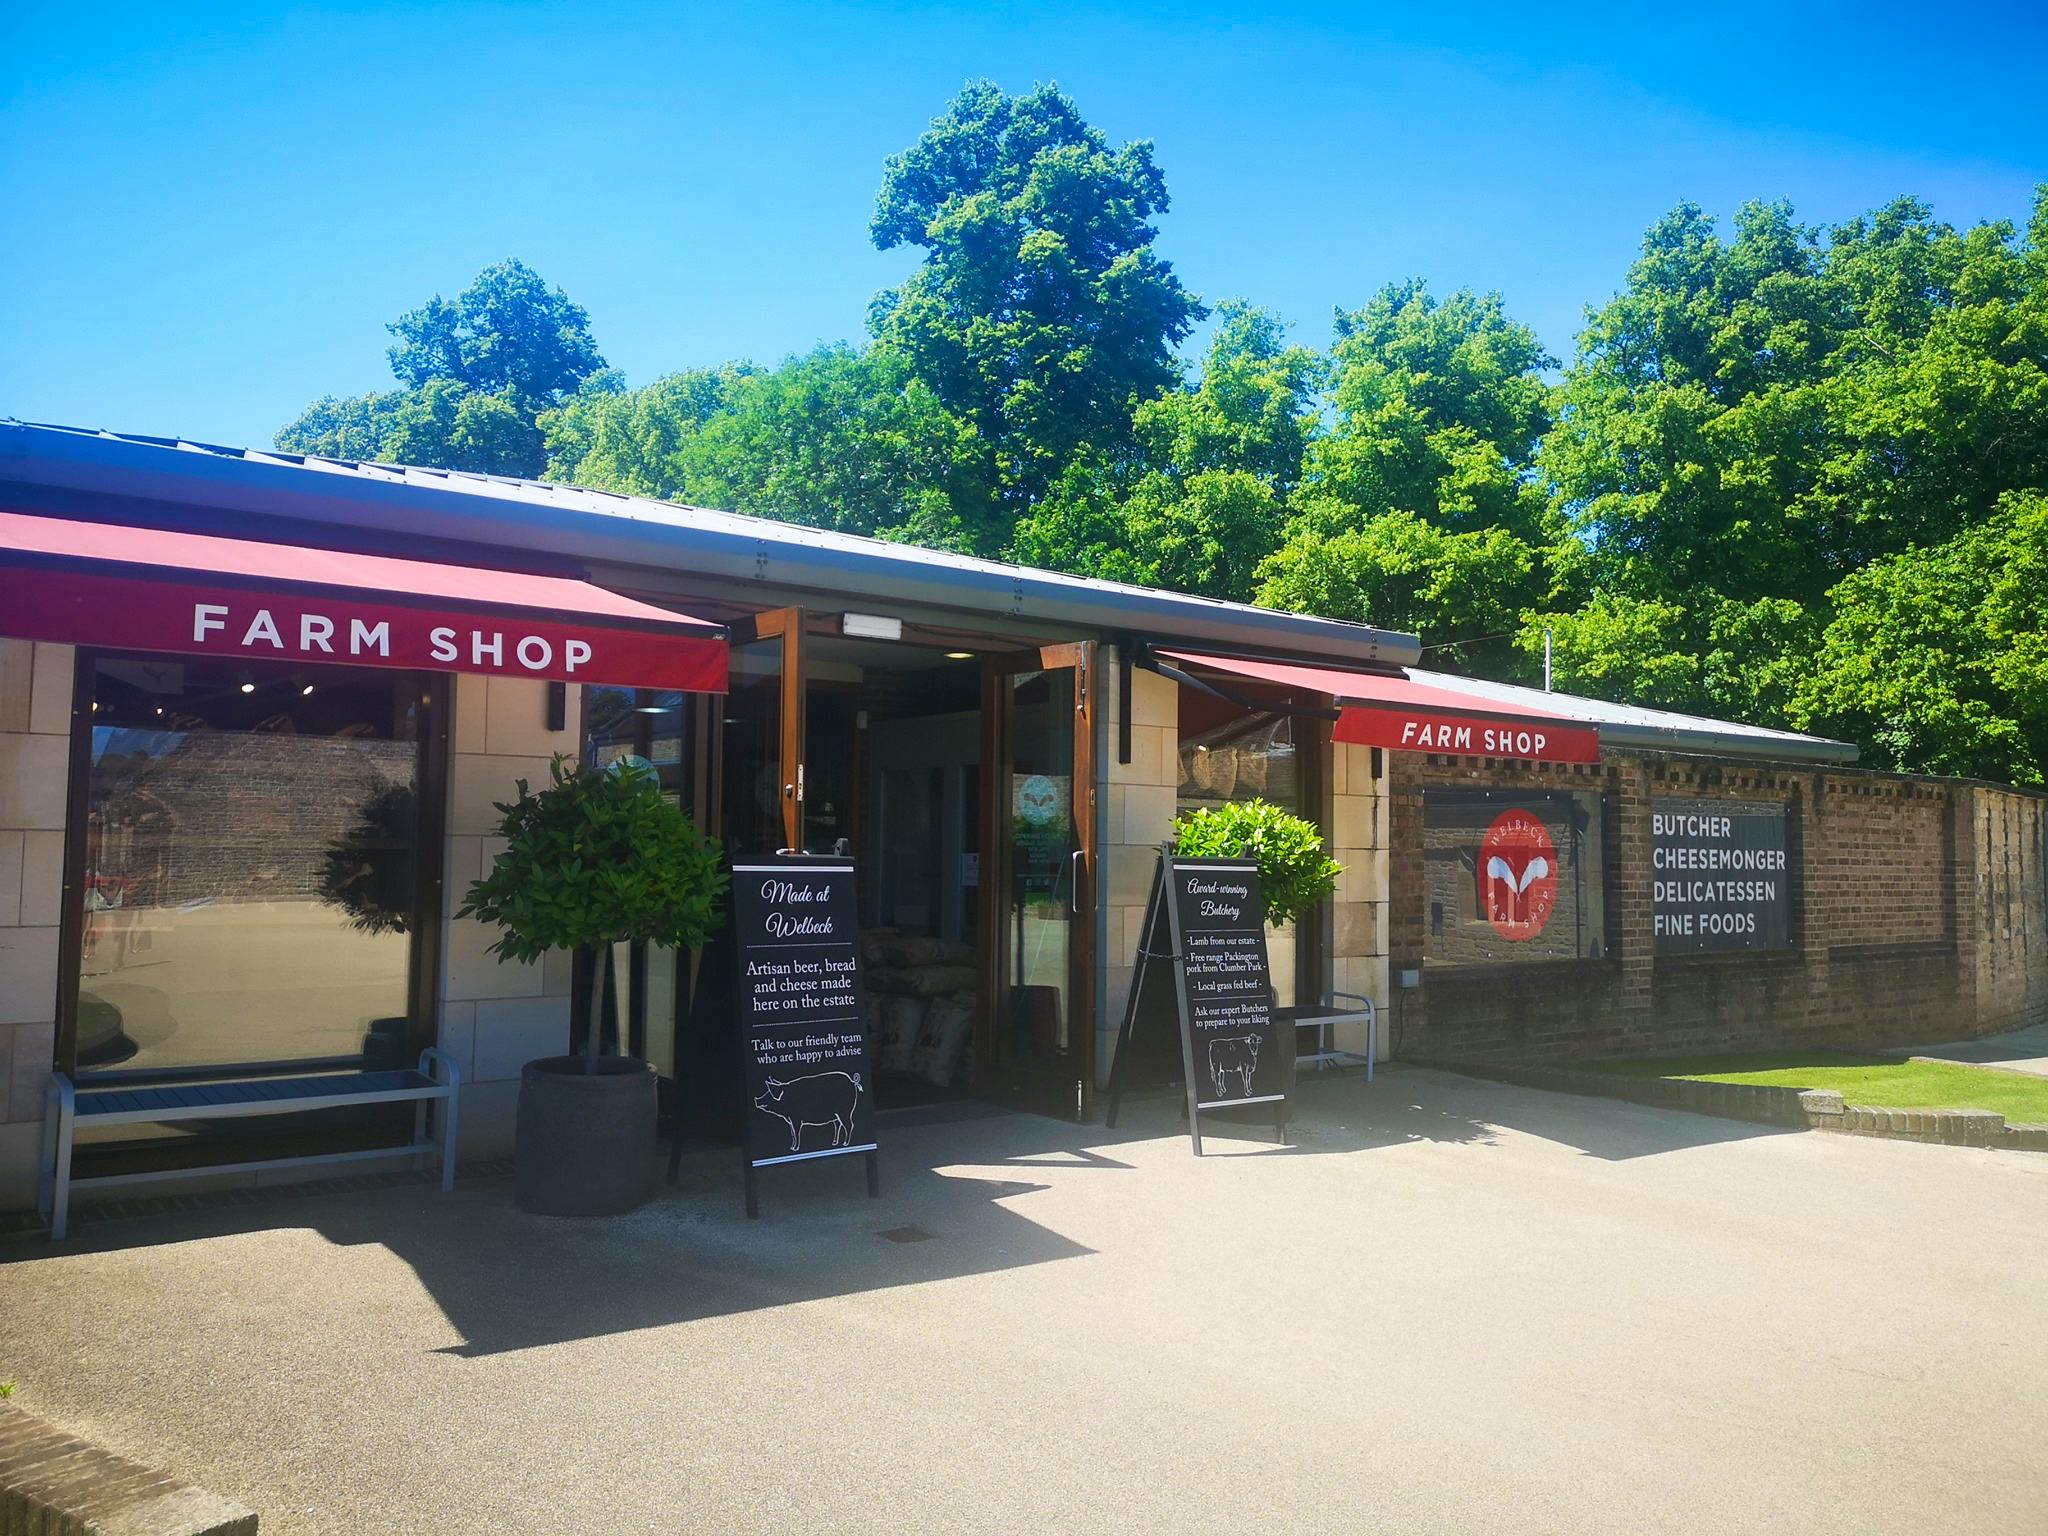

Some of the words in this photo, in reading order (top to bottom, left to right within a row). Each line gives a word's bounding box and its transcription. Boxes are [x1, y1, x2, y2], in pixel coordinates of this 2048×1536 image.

[193, 604, 391, 658] FARM
[430, 627, 594, 673] SHOP
[1401, 722, 1472, 748] FARM
[1485, 728, 1547, 755] SHOP
[1490, 819, 1545, 848] WELBECK
[1653, 815, 1731, 839] BUTCHER
[1653, 848, 1786, 871] CHEESEMONGER
[761, 878, 812, 904] Made
[816, 885, 830, 902] at
[1187, 877, 1248, 900] Award-winning
[1653, 881, 1775, 902] DELICATESSEN
[1200, 900, 1240, 921] Butchery
[1488, 892, 1515, 929] FARM
[1523, 890, 1551, 929] SHOP
[765, 912, 833, 939] Welbeck
[1654, 914, 1694, 935] FINE
[1699, 912, 1755, 935] FOODS
[1210, 935, 1225, 946] from
[1226, 938, 1237, 946] our
[1238, 937, 1256, 945] estate
[746, 961, 791, 976] Artisan
[793, 959, 822, 975] beer,
[825, 957, 856, 972] bread
[1190, 952, 1205, 962] Free
[1206, 955, 1224, 964] range
[1224, 952, 1259, 963] Packington
[1186, 963, 1202, 976] pork
[1202, 963, 1219, 973] from
[1219, 962, 1247, 972] Clumber
[1247, 962, 1263, 972] Park
[754, 978, 777, 993] and
[780, 977, 818, 992] cheese
[821, 974, 852, 989] made
[1197, 981, 1216, 991] Local
[1216, 983, 1233, 993] grass
[1233, 980, 1244, 990] fed
[1244, 979, 1259, 989] beef
[753, 997, 779, 1011] here
[782, 999, 798, 1010] on
[801, 994, 820, 1008] the
[823, 995, 855, 1007] estate
[1194, 1006, 1208, 1017] Ask
[1208, 1008, 1220, 1016] our
[1221, 1006, 1241, 1017] expert
[1241, 1003, 1269, 1014] Butchers
[1195, 1019, 1204, 1028] to
[1204, 1019, 1228, 1030] prepare
[1229, 1017, 1236, 1026] to
[1236, 1016, 1251, 1028] your
[1251, 1014, 1270, 1026] liking
[751, 1039, 774, 1051] Talk
[776, 1040, 786, 1049] to
[787, 1039, 803, 1049] our
[805, 1033, 839, 1047] friendly
[840, 1033, 862, 1044] team
[756, 1053, 777, 1065] who
[779, 1053, 793, 1063] are
[795, 1050, 823, 1064] happy
[824, 1049, 834, 1059] to
[836, 1045, 862, 1057] advise
